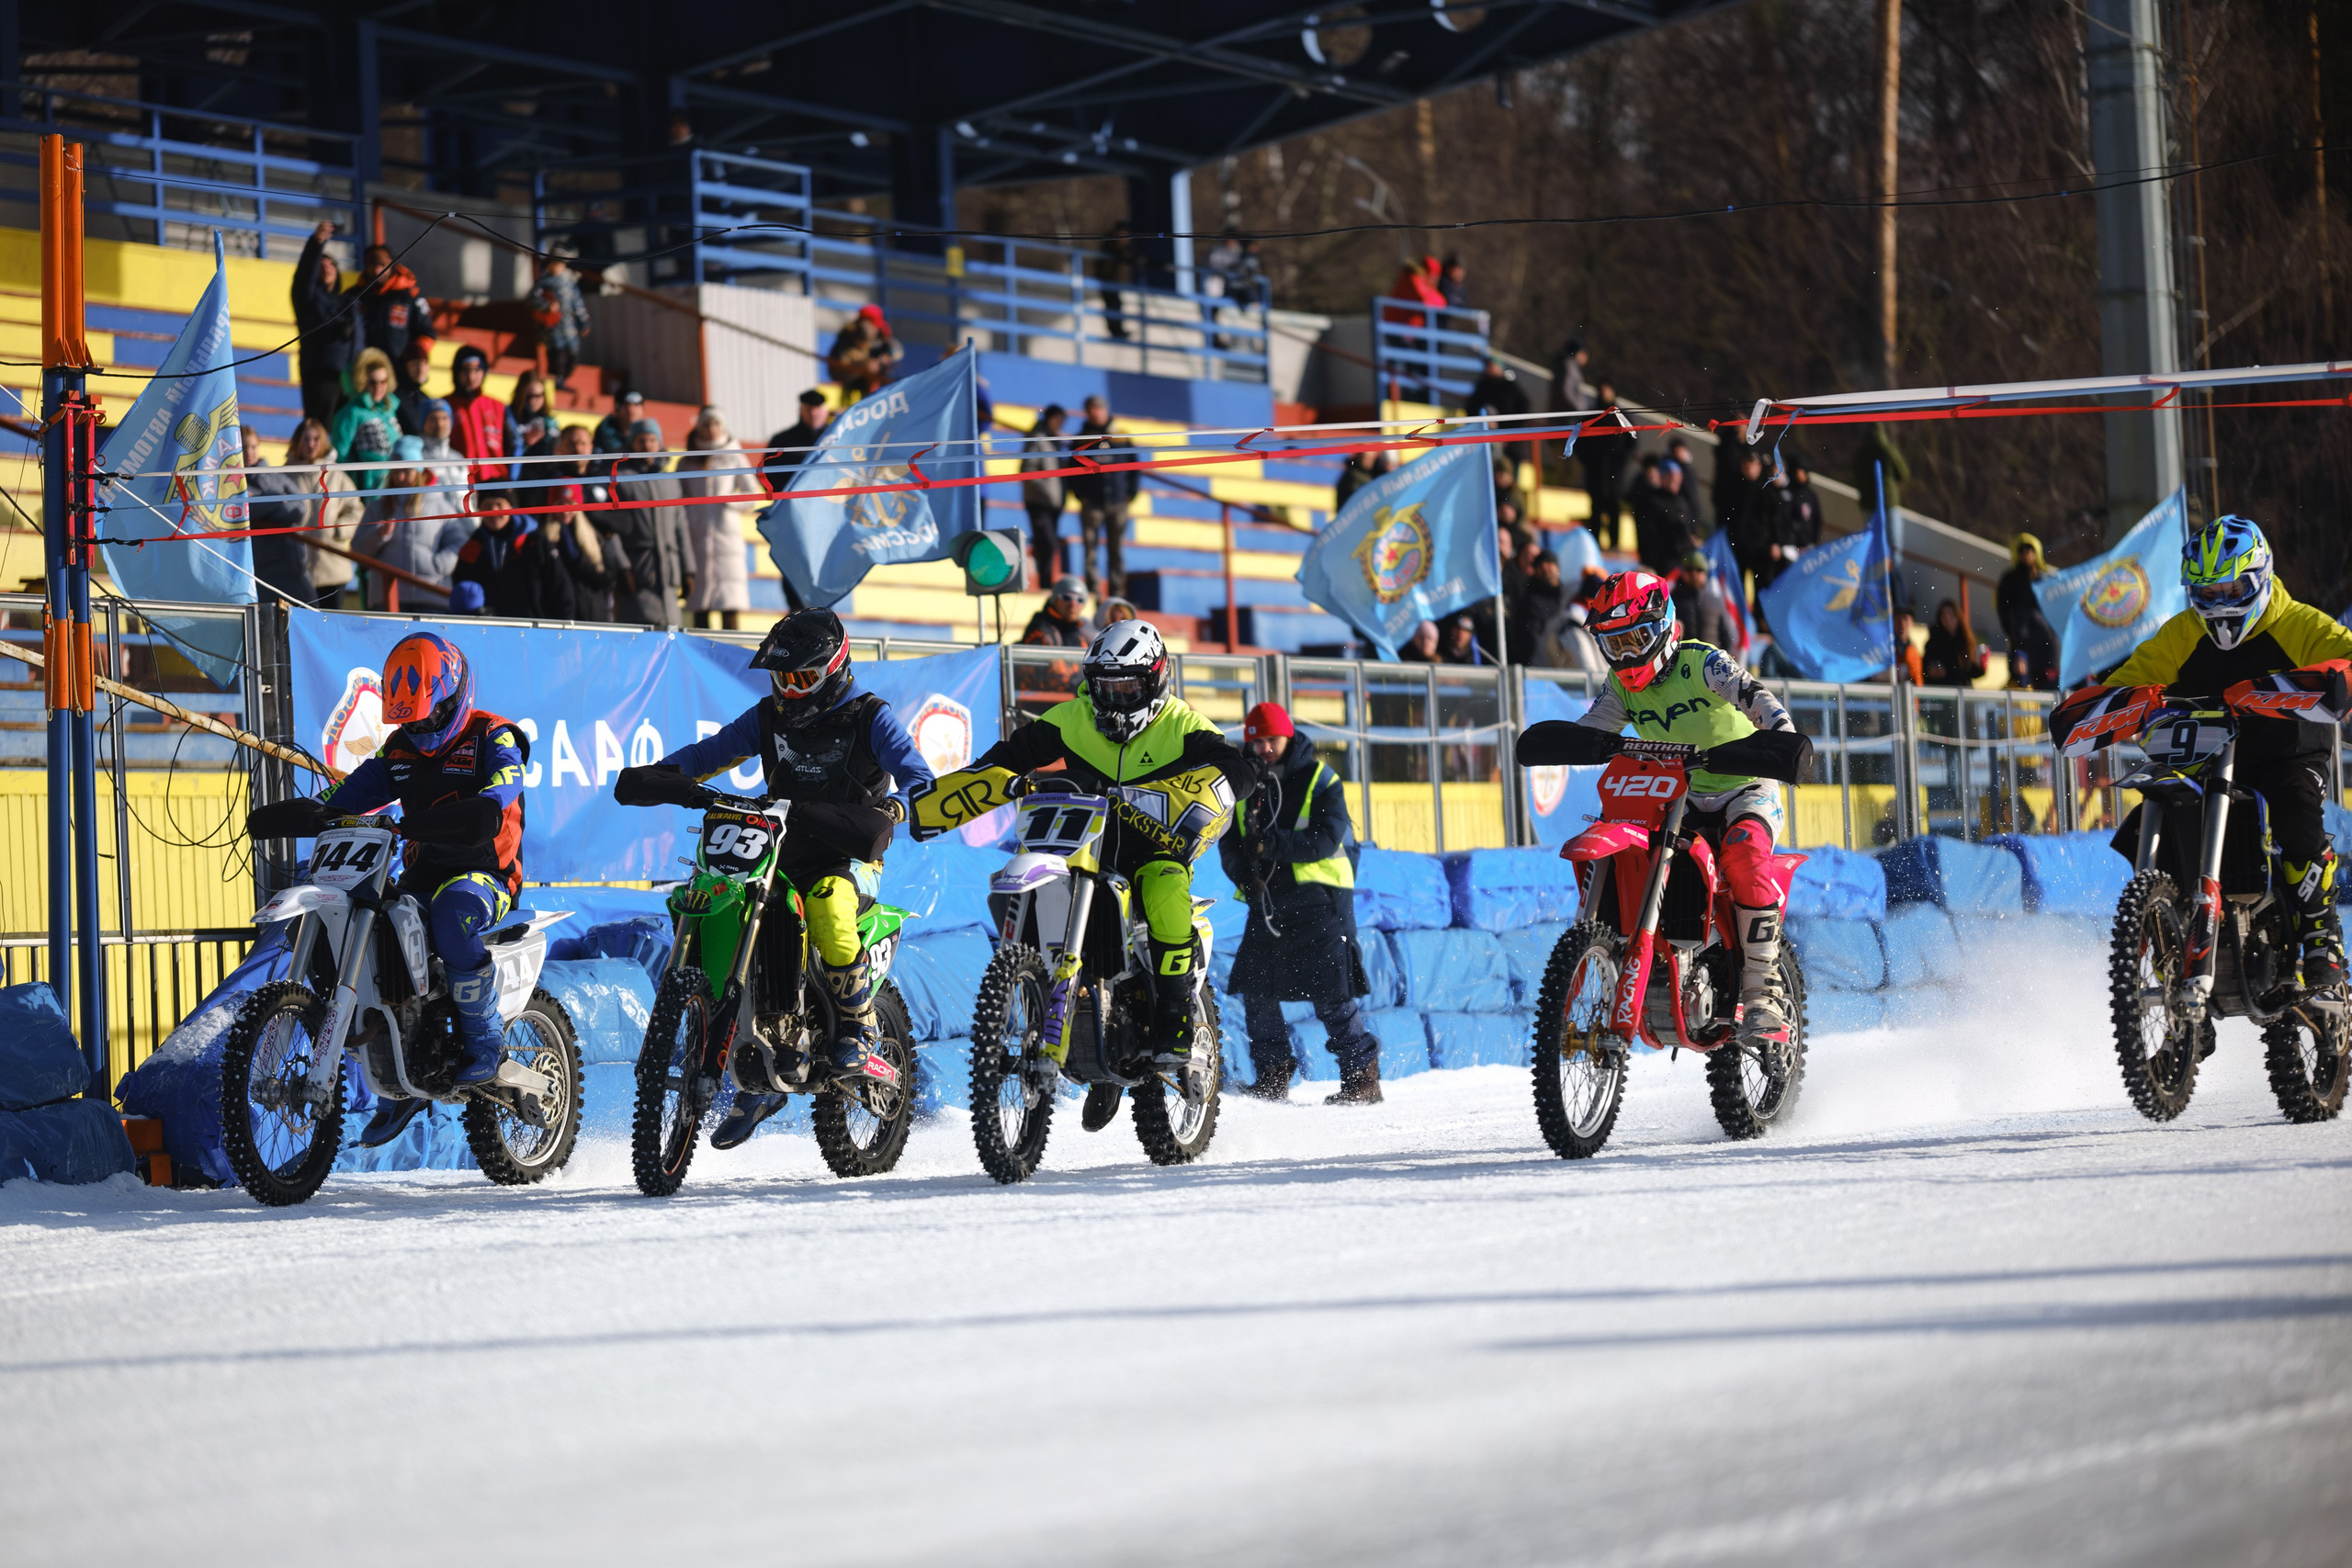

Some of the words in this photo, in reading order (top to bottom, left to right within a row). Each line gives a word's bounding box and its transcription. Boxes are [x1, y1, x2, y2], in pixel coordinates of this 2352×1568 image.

[2233, 691, 2326, 711] KTM
[2064, 701, 2149, 746] KTM
[517, 717, 664, 788] СААФ
[1623, 742, 1691, 752] RENTHAL
[2168, 720, 2199, 766] 9
[795, 764, 822, 774] ATLAS
[1603, 775, 1679, 798] 420
[722, 813, 743, 821] PAVEL
[1024, 807, 1096, 842] 11
[310, 840, 383, 874] 144
[705, 823, 769, 860] 93
[2298, 863, 2324, 903] SIDI
[869, 937, 892, 981] 93
[1616, 956, 1642, 1025] RACING
[866, 1060, 894, 1081] RACING
